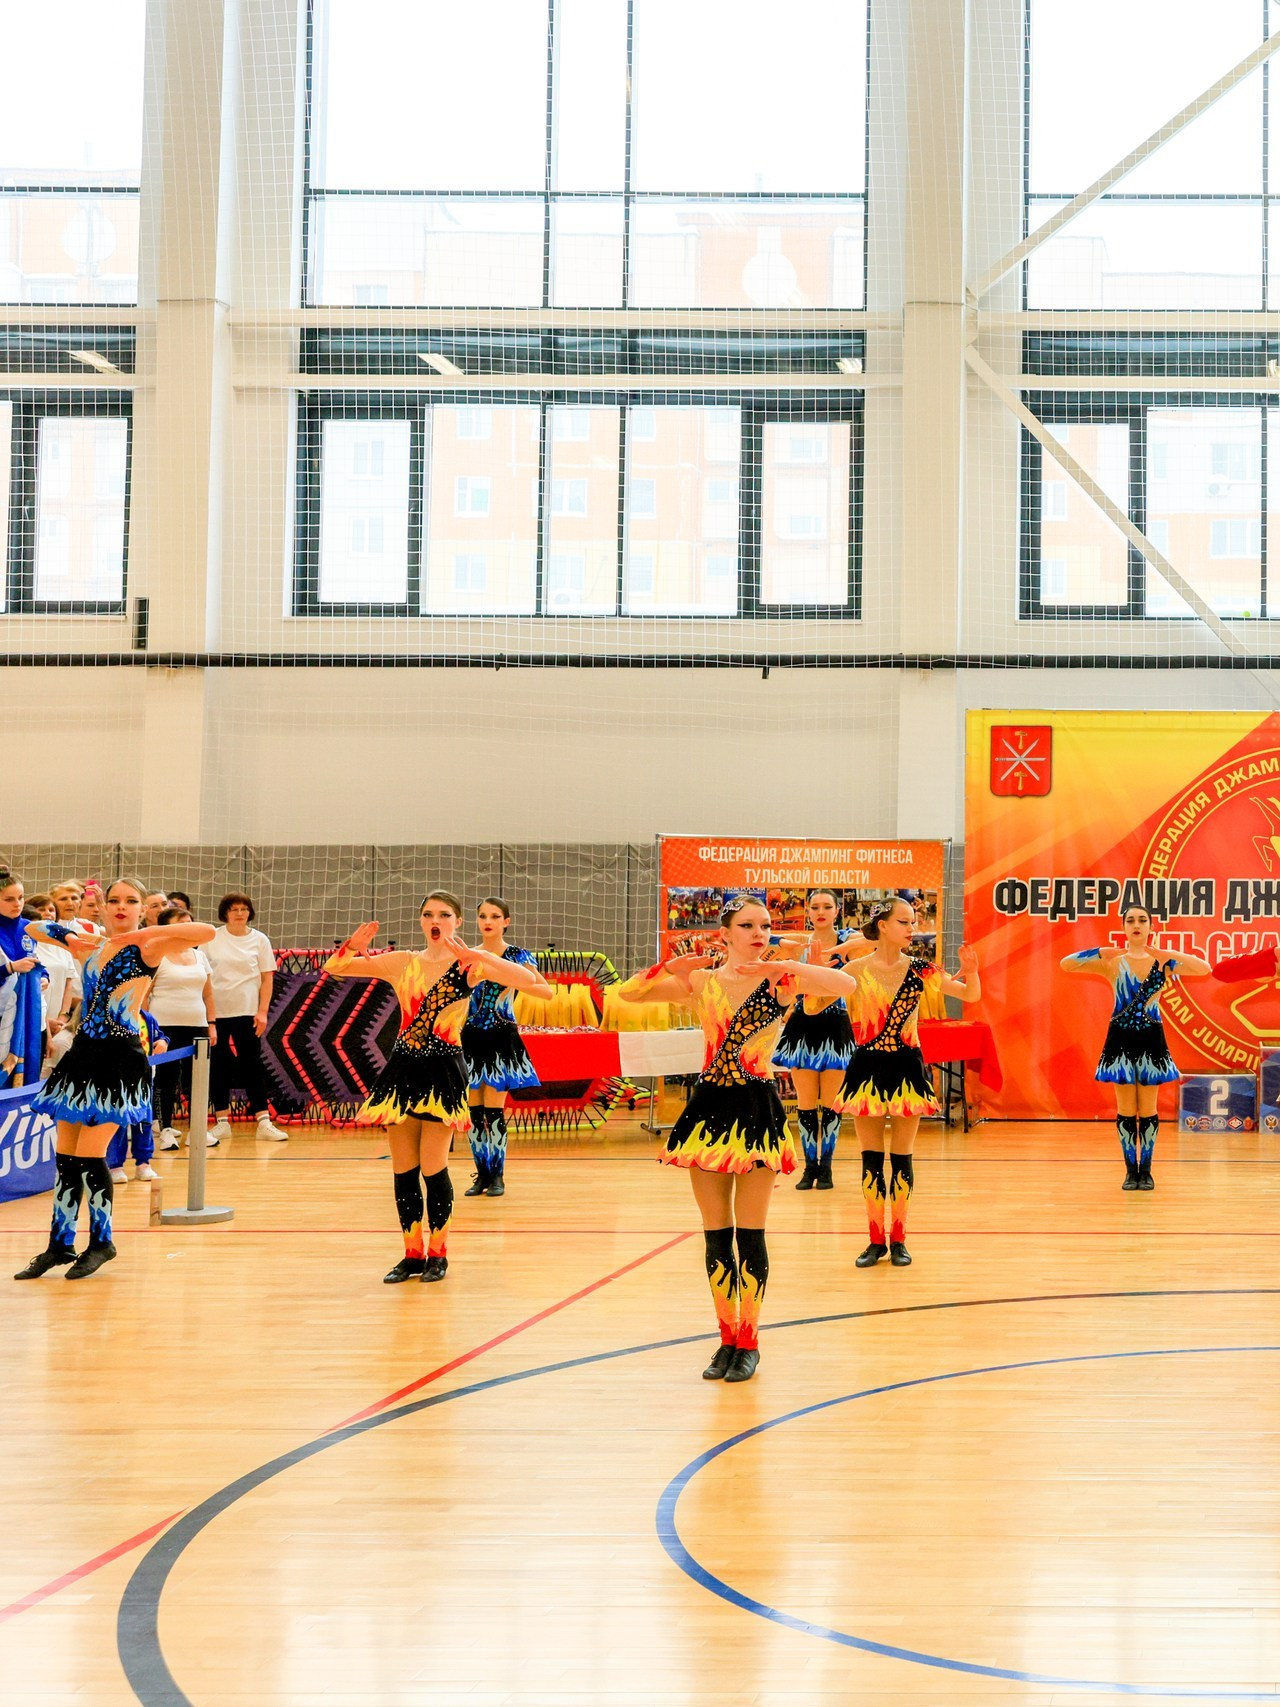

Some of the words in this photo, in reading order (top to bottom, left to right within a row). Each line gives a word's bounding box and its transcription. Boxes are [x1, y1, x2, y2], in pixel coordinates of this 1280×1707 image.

[1148, 791, 1212, 879] ДЕРАЦИЯ
[698, 847, 777, 863] ФЕДЕРАЦИЯ
[780, 848, 853, 864] ДЖАМПИНГ
[856, 848, 913, 864] ФИТНЕСА
[745, 867, 811, 884] ТУЛЬСКОЙ
[813, 869, 870, 885] ОБЛАСТИ
[994, 877, 1216, 922] ФЕДЕРАЦИЯ
[1210, 1079, 1230, 1116] 2
